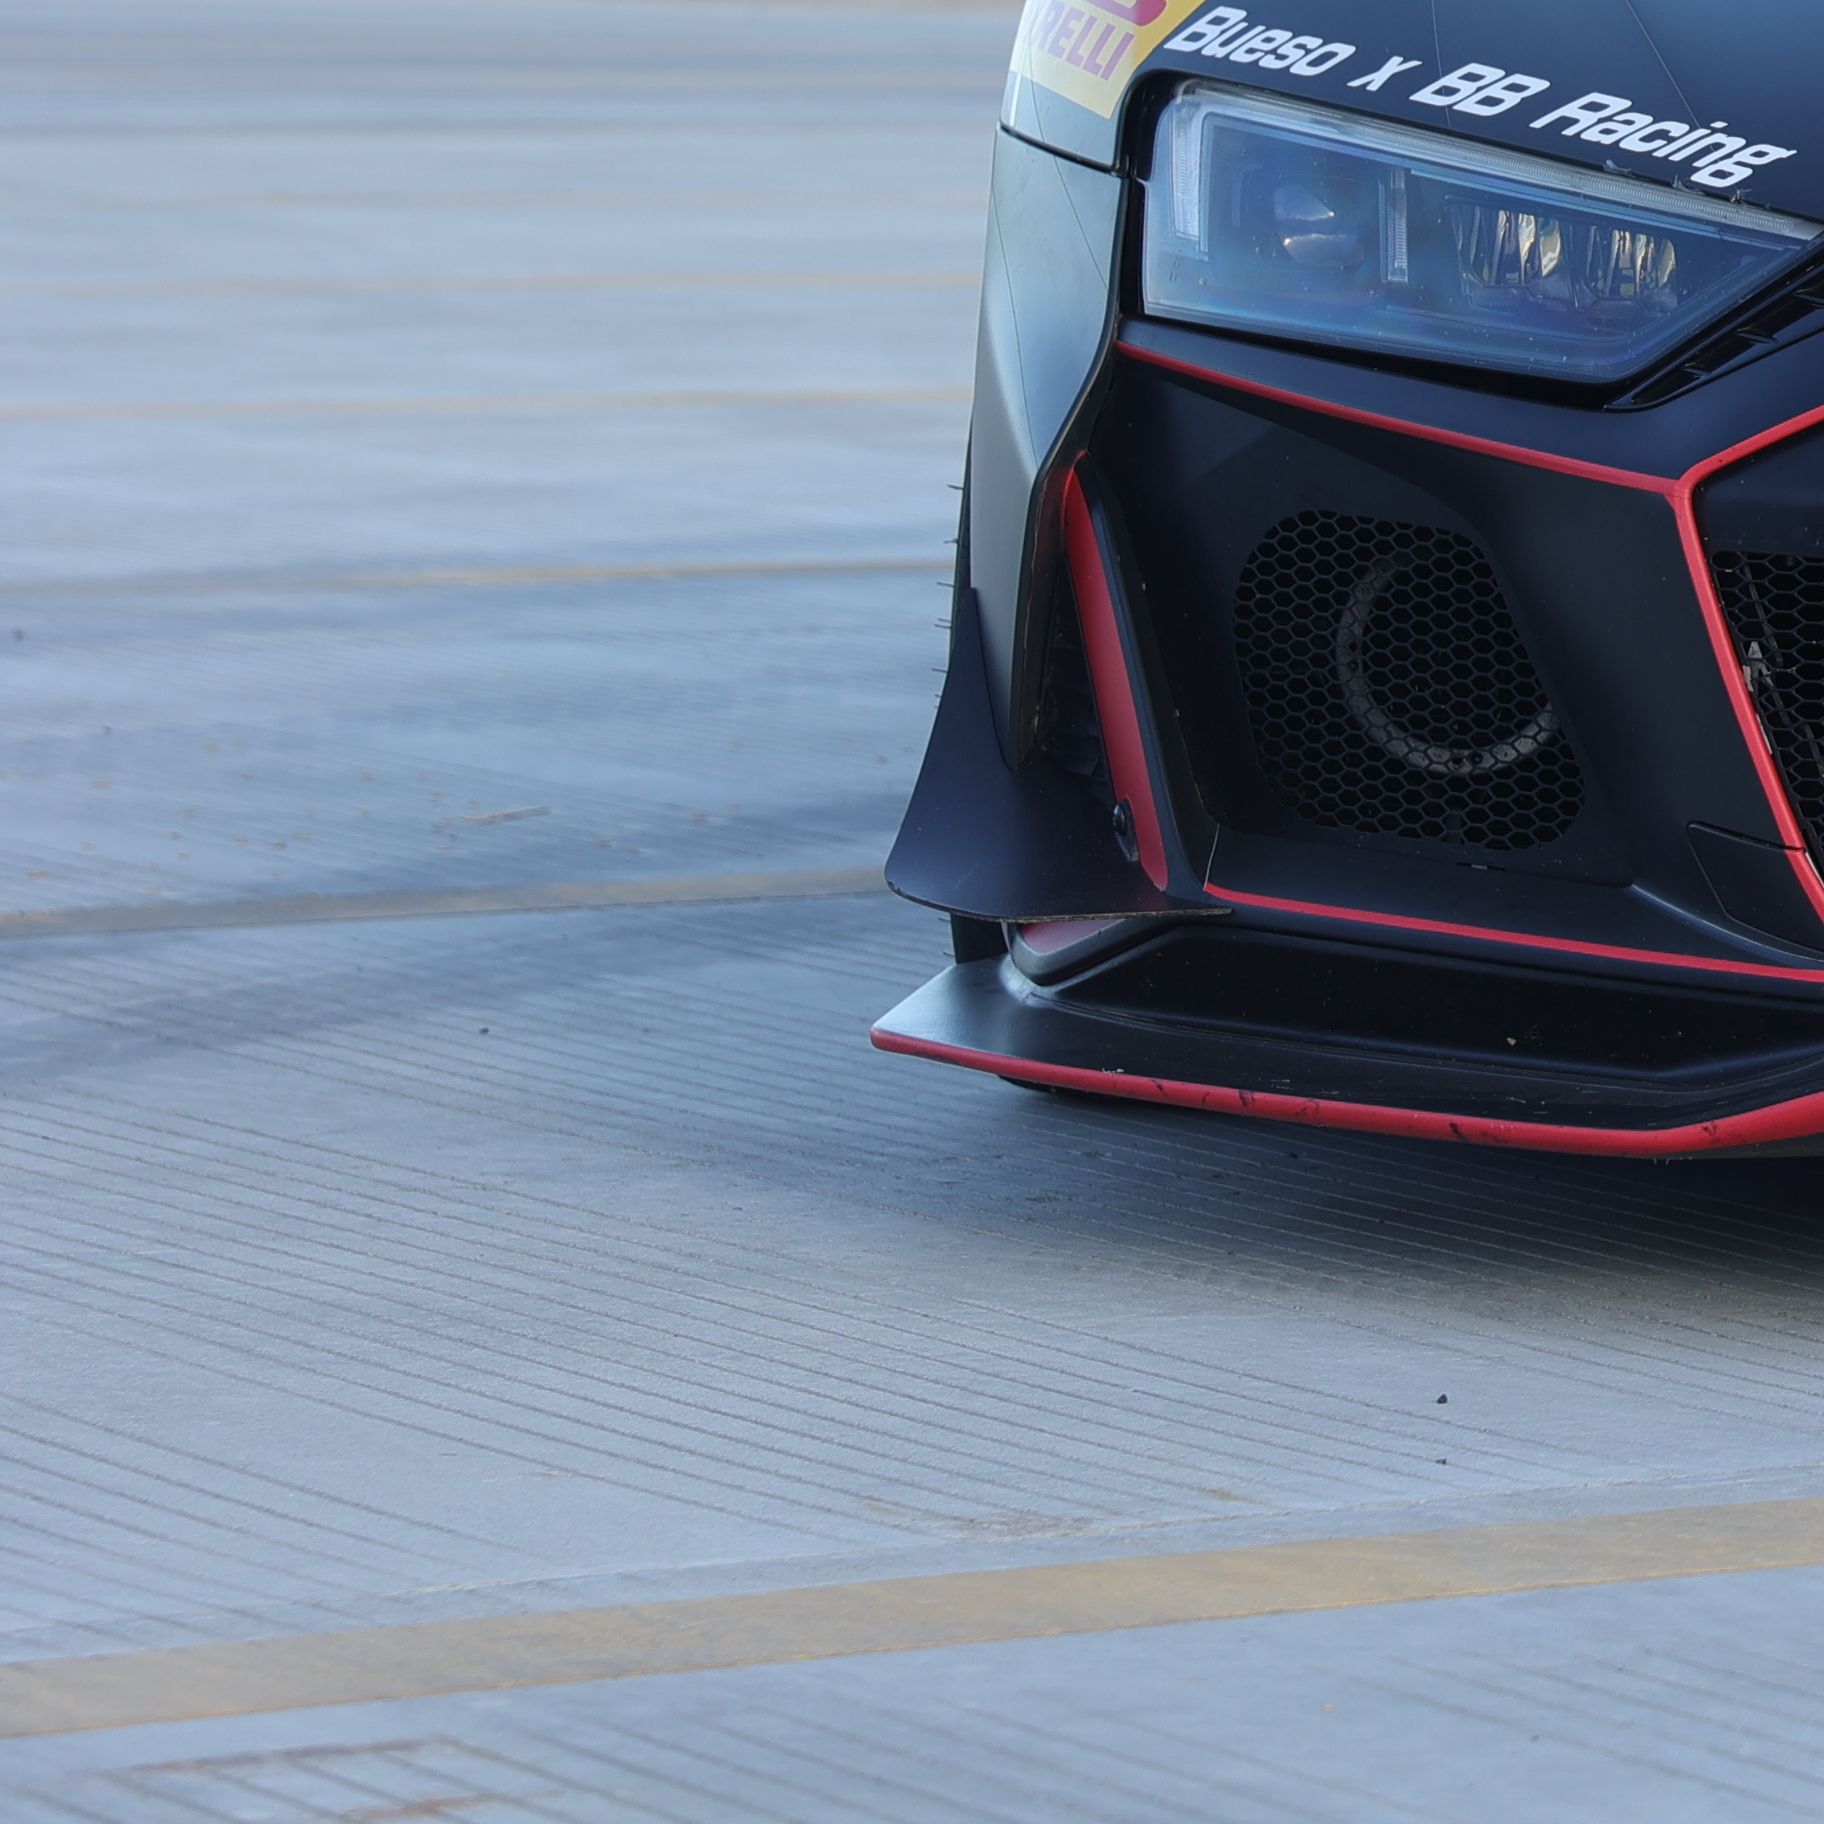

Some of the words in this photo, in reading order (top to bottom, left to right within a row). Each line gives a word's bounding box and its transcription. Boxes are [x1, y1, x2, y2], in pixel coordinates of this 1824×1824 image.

[1163, 6, 1357, 77] Bueso
[1347, 57, 1422, 92] x
[1409, 62, 1551, 117] BB
[1528, 92, 1798, 189] Racing
